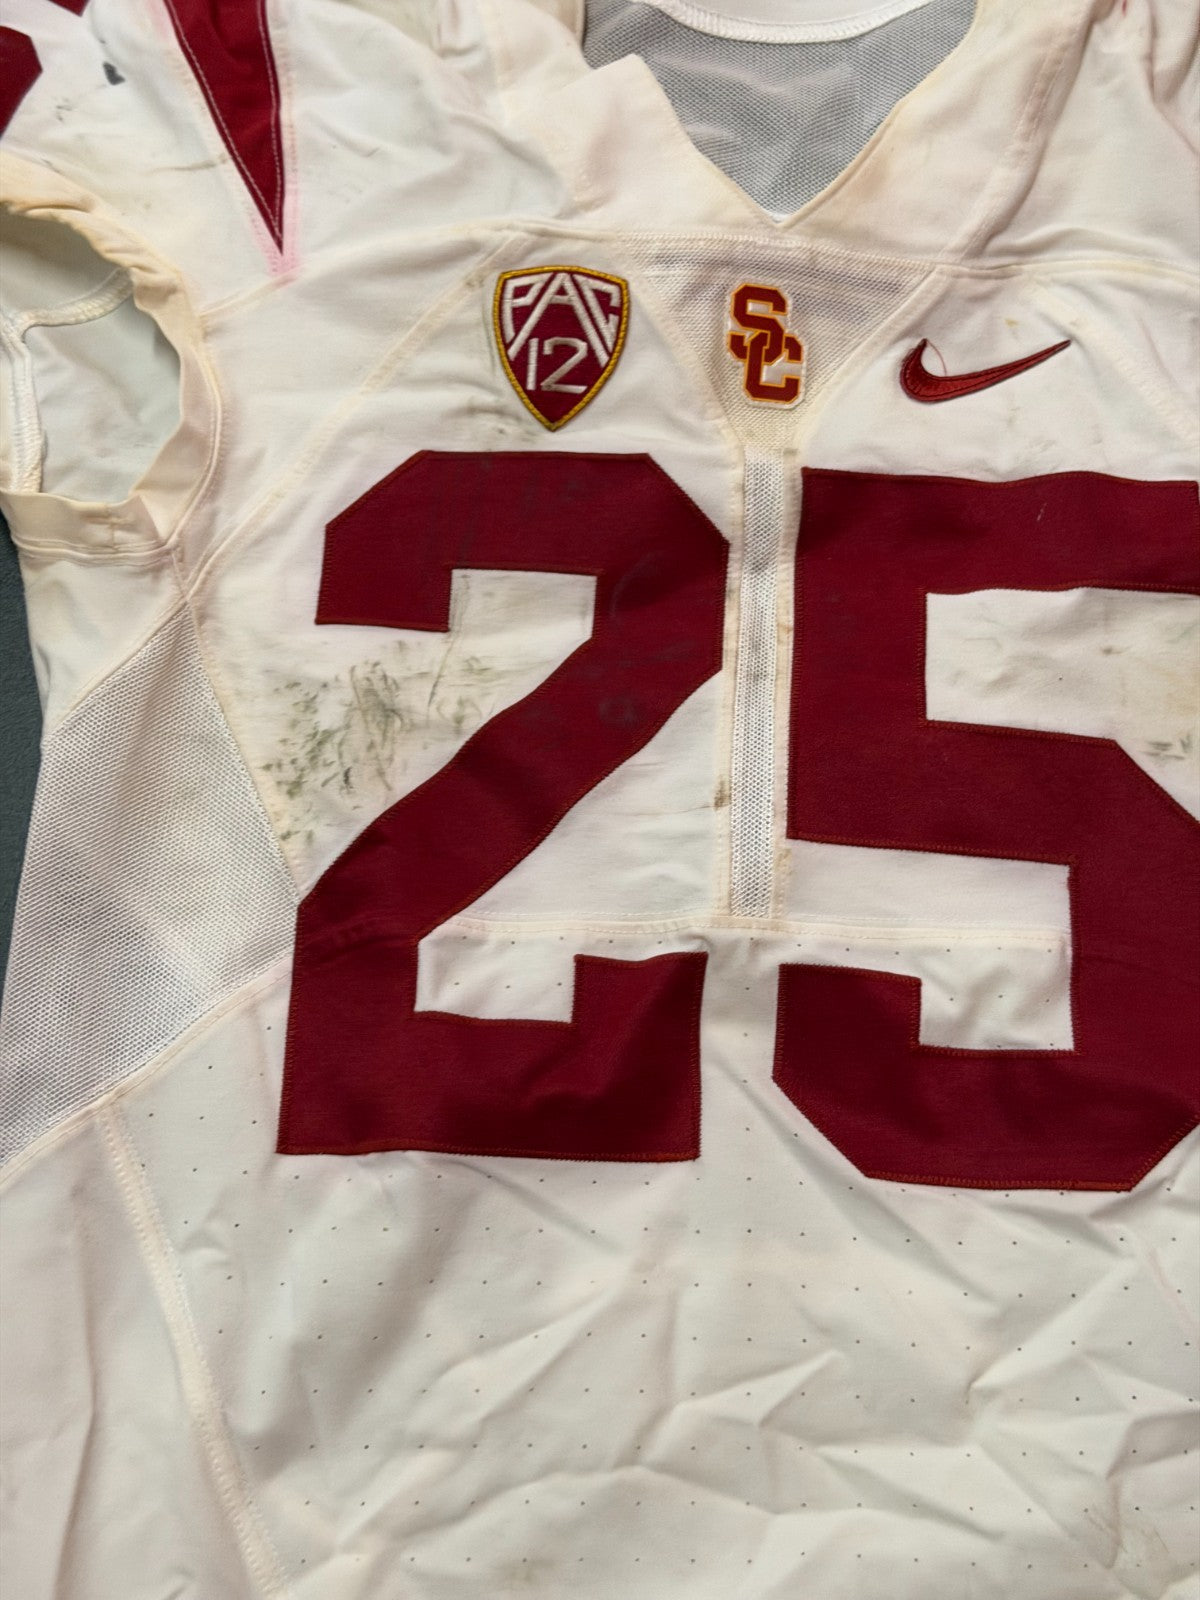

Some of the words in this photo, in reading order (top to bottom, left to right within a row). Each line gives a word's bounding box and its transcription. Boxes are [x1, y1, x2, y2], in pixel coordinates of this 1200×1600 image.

[502, 271, 620, 368] PAC
[526, 336, 588, 394] 12
[276, 449, 1200, 1192] 25
